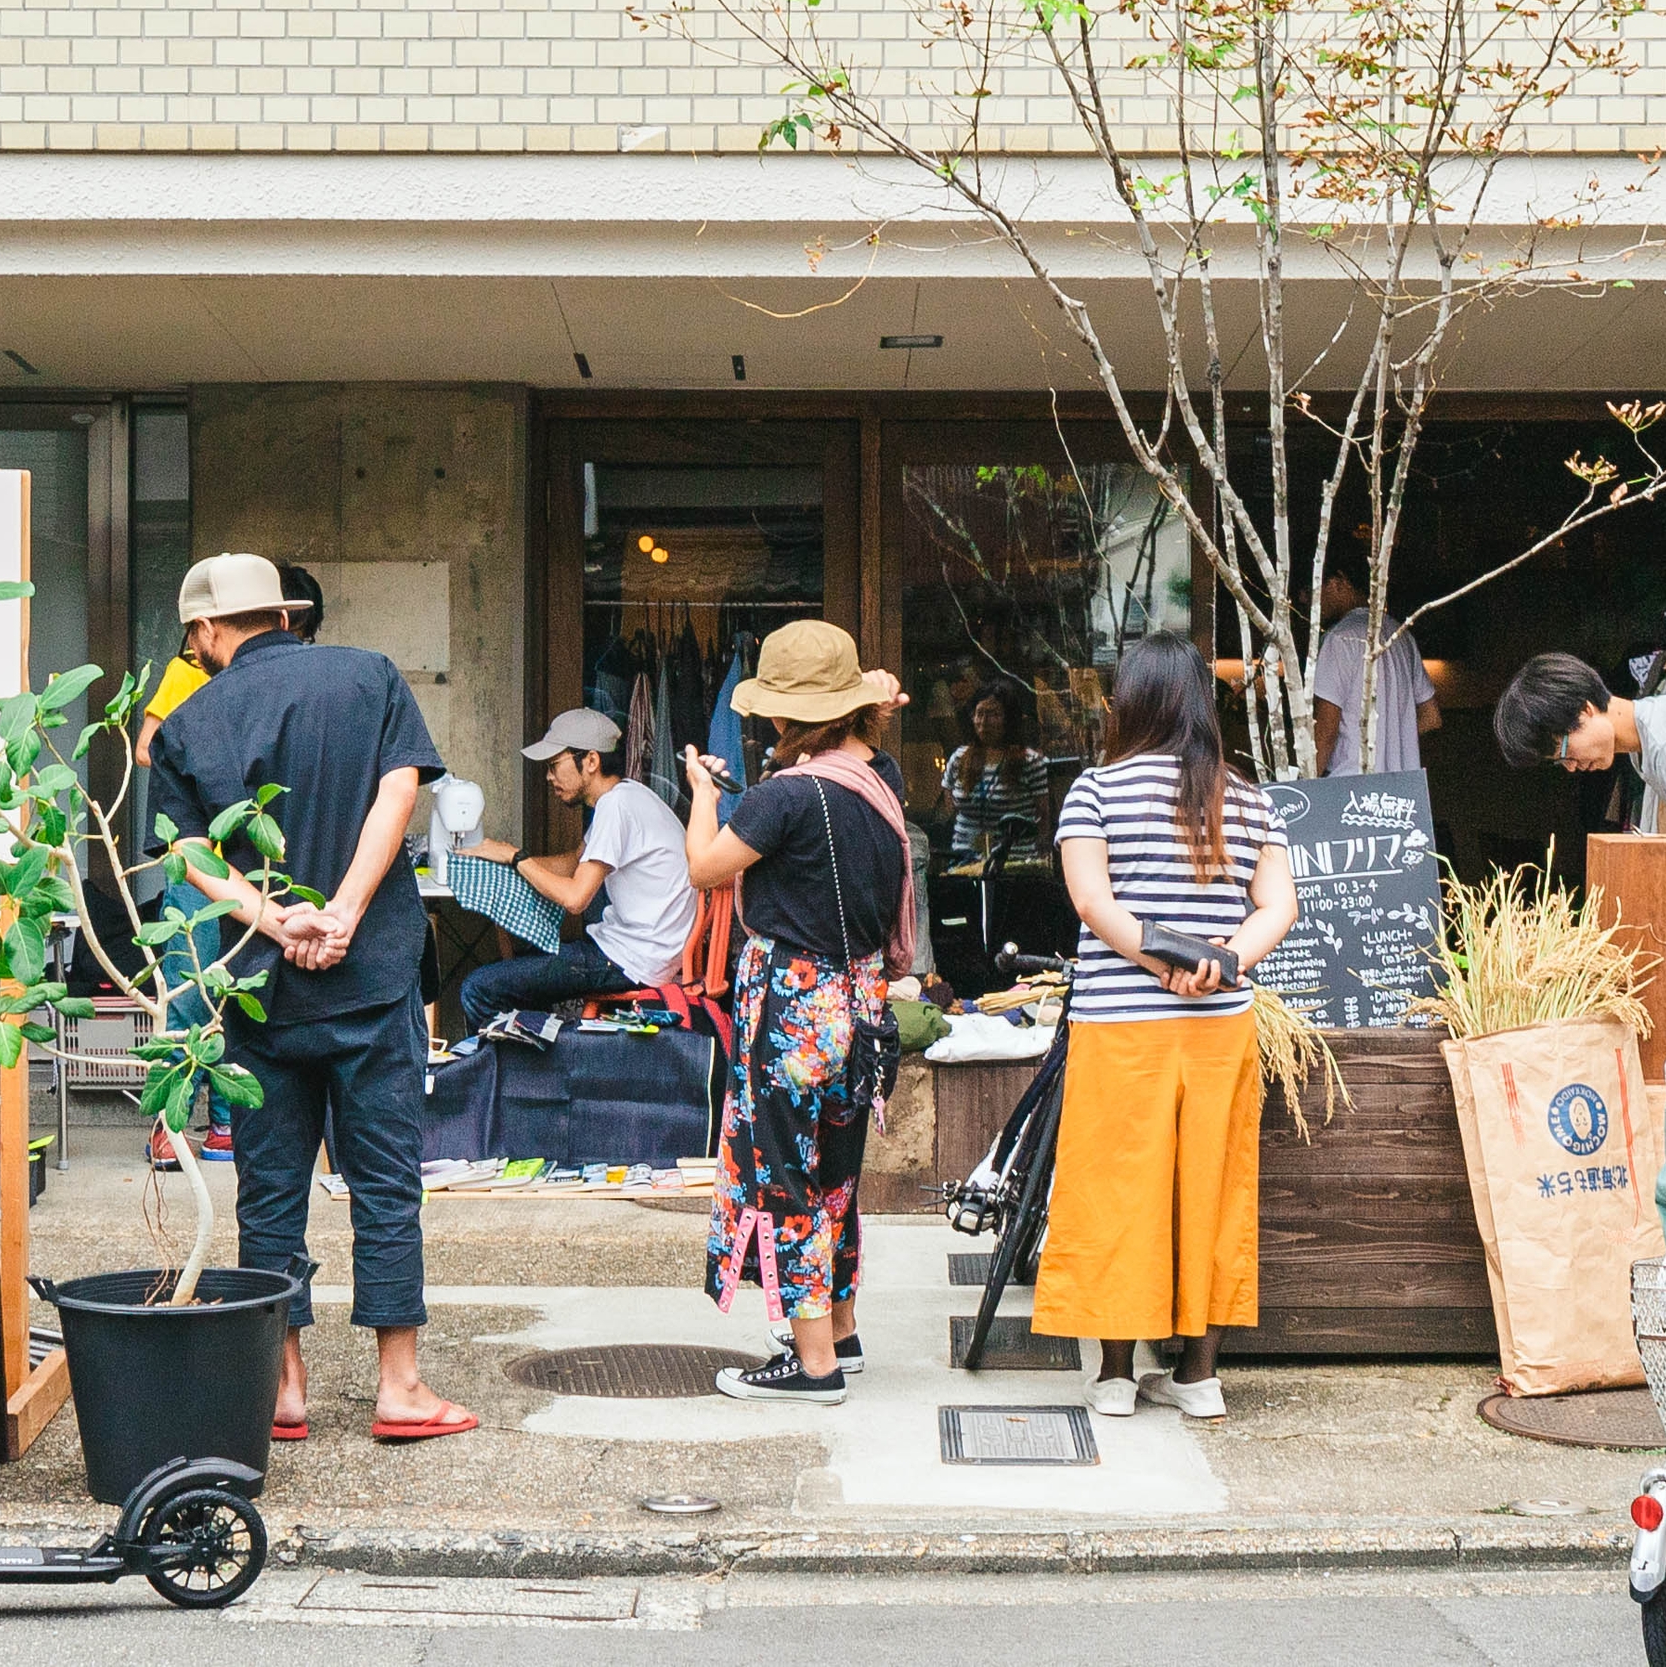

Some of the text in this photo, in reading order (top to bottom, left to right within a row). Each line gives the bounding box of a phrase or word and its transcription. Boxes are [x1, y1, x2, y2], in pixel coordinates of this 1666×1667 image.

[1343, 790, 1418, 821] 入場無料
[1303, 896, 1373, 913] 11:00-23:00
[1555, 1086, 1598, 1106] HOKKAIDO
[1550, 1113, 1607, 1153] MOCHIGOME
[1536, 1164, 1629, 1199] 北海道もち米
